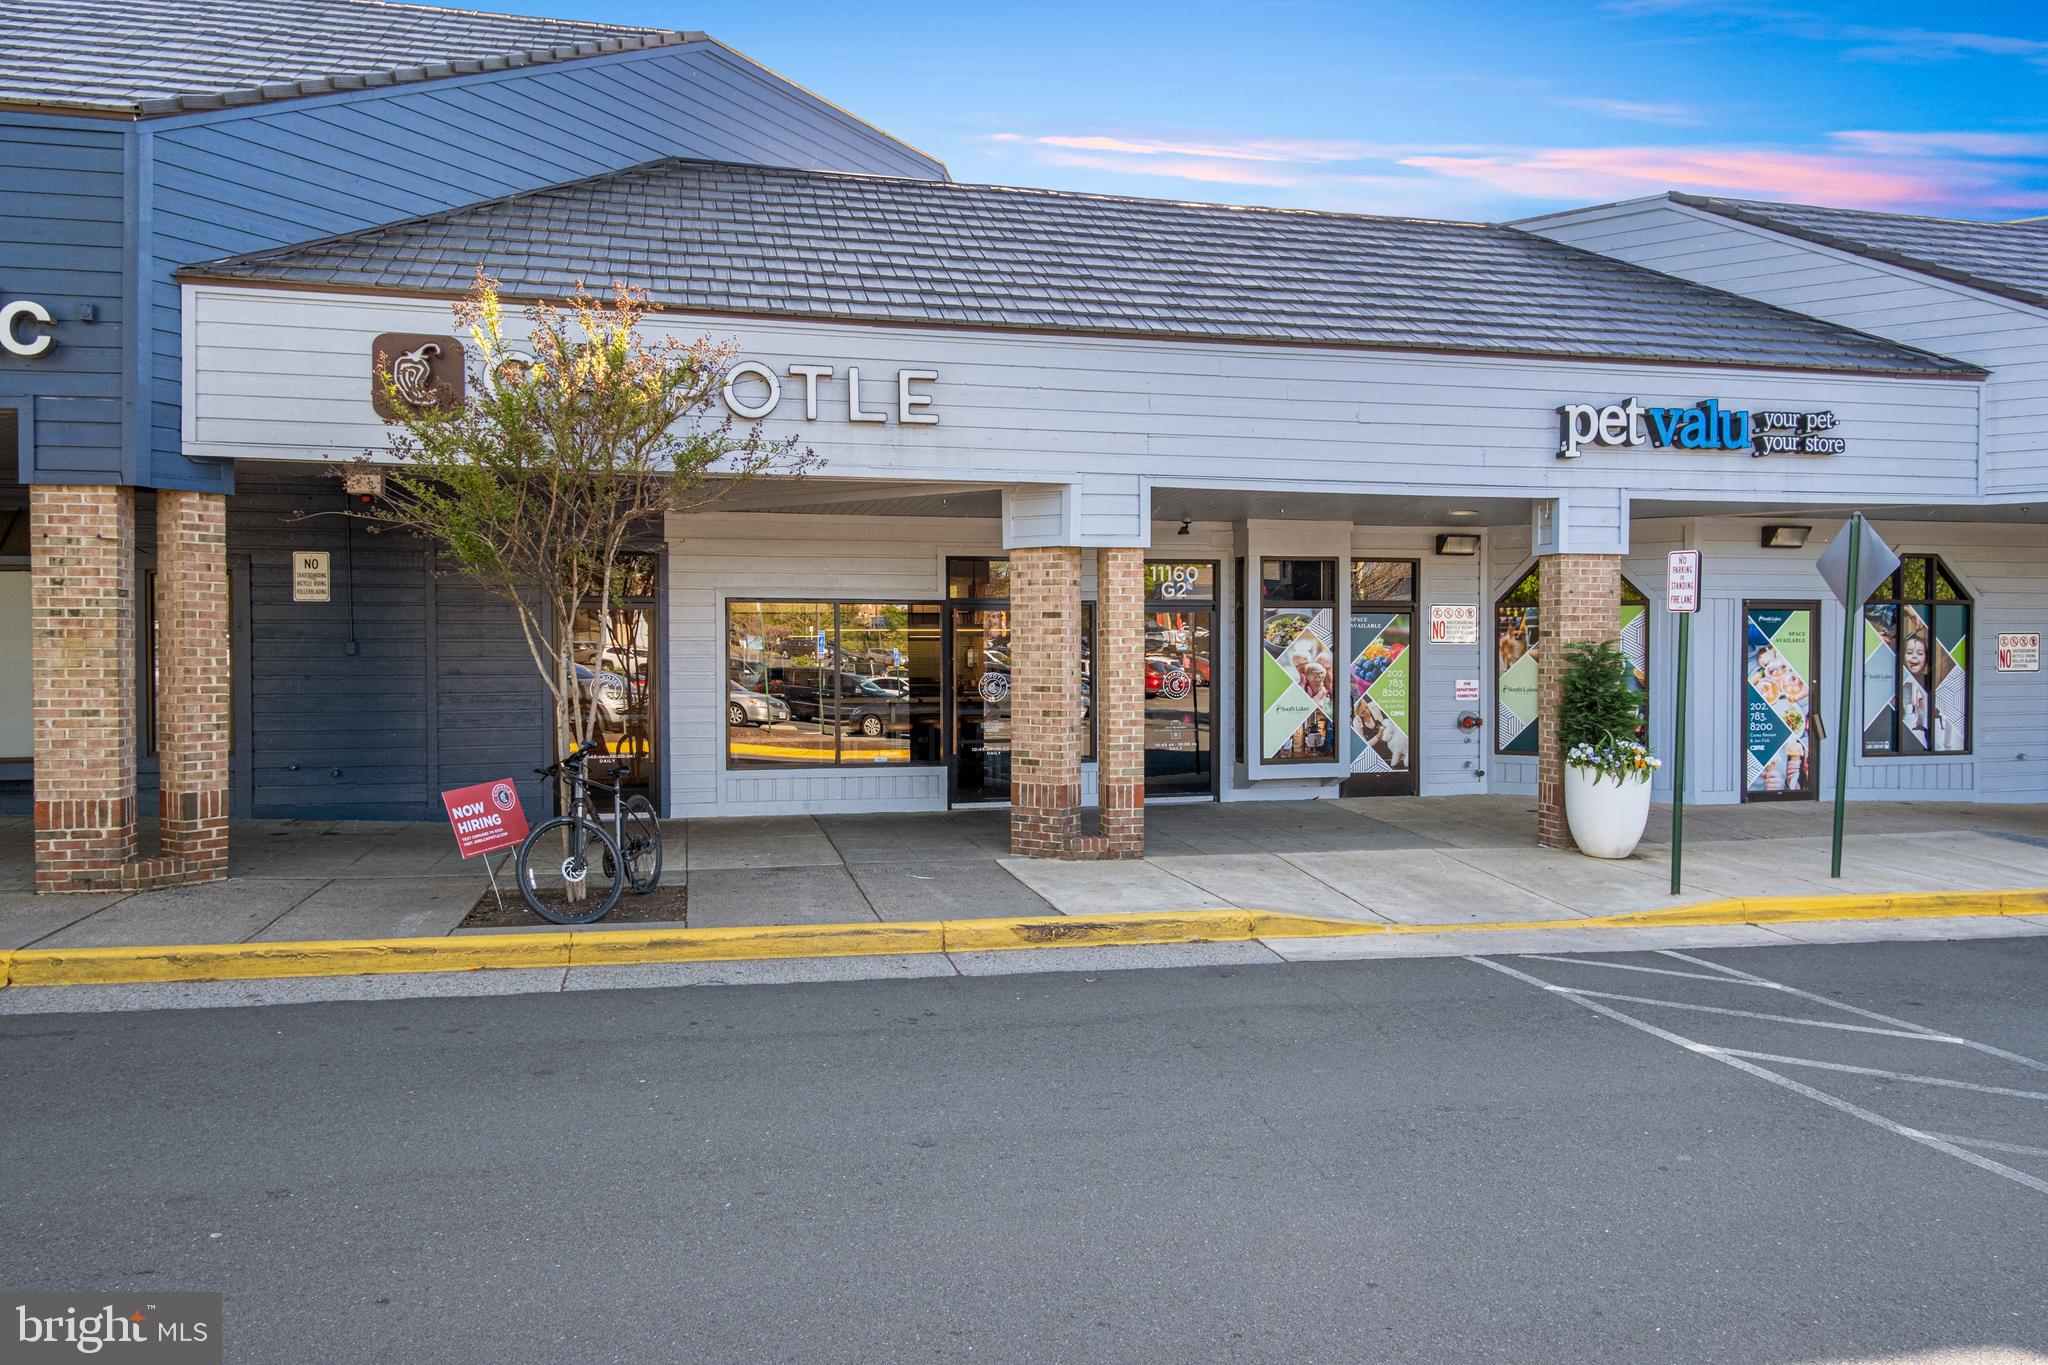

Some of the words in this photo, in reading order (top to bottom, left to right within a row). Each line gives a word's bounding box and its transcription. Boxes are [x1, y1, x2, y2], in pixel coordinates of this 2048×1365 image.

[483, 349, 940, 424] CPOTLE
[1763, 411, 1800, 432] your
[1763, 436, 1800, 456] your
[1805, 435, 1844, 453] store
[304, 558, 319, 570] NO
[1678, 556, 1687, 565] NO
[1150, 565, 1199, 582] 11160
[1672, 565, 1693, 574] PARKING
[1161, 581, 1187, 598] G2
[1670, 581, 1694, 590] STANDING
[1671, 594, 1680, 604] FIRE
[1681, 594, 1694, 604] LANE
[1432, 620, 1446, 640] NO
[2000, 649, 2012, 668] NO
[1382, 688, 1406, 697] 8200
[1750, 702, 1769, 711] 202.
[1750, 721, 1773, 731] 8200
[451, 801, 485, 820] NOW
[457, 813, 502, 834] HIRING
